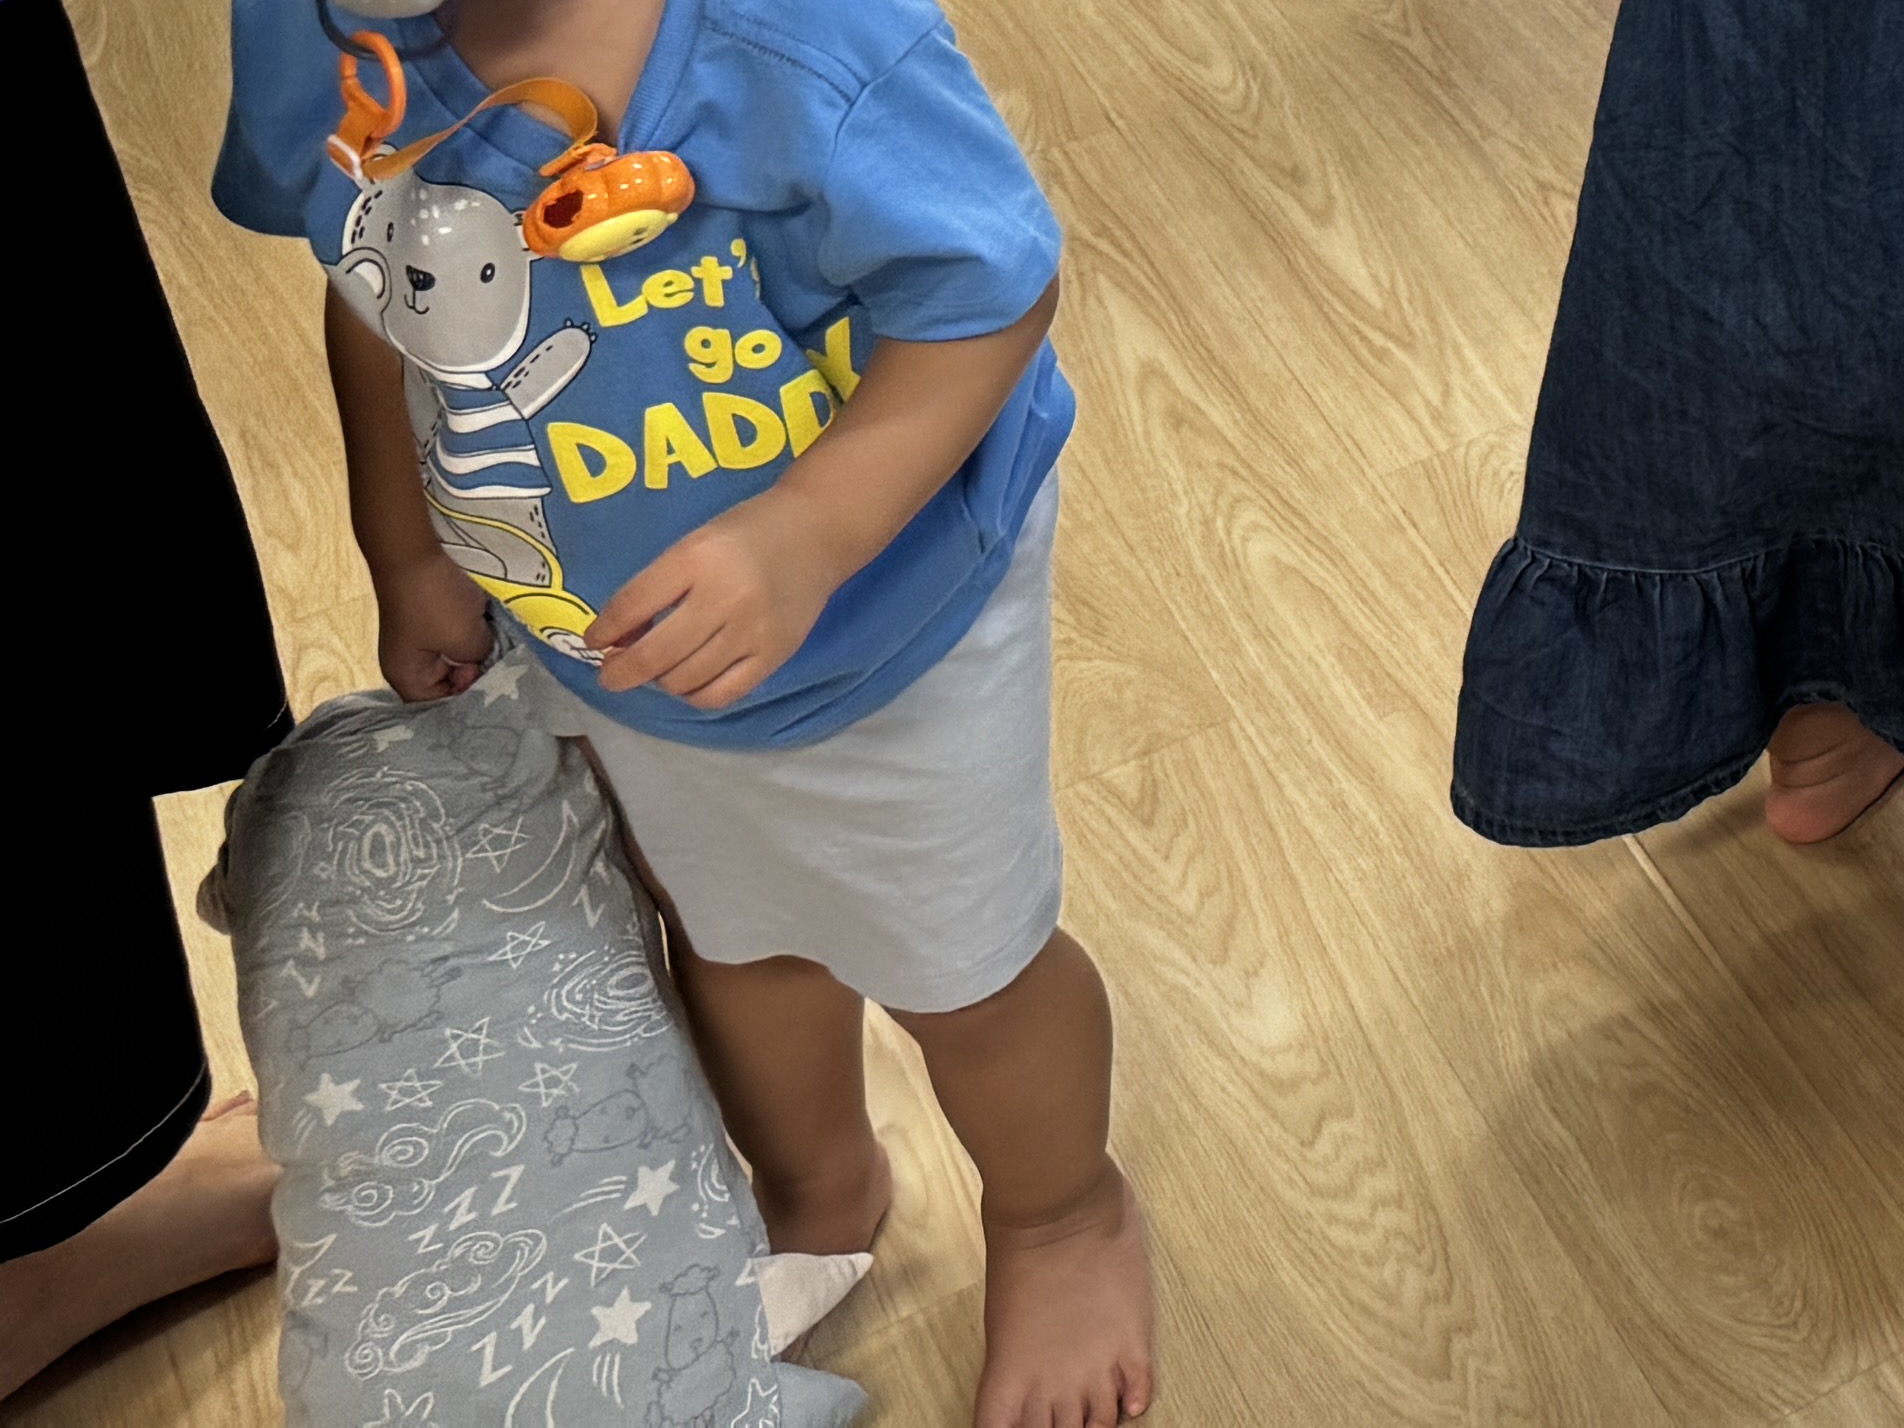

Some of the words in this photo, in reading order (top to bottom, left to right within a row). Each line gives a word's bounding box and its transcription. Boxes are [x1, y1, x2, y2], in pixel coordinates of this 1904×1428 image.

[579, 237, 761, 328] Let'
[683, 325, 783, 384] go
[546, 315, 862, 504] DADDY
